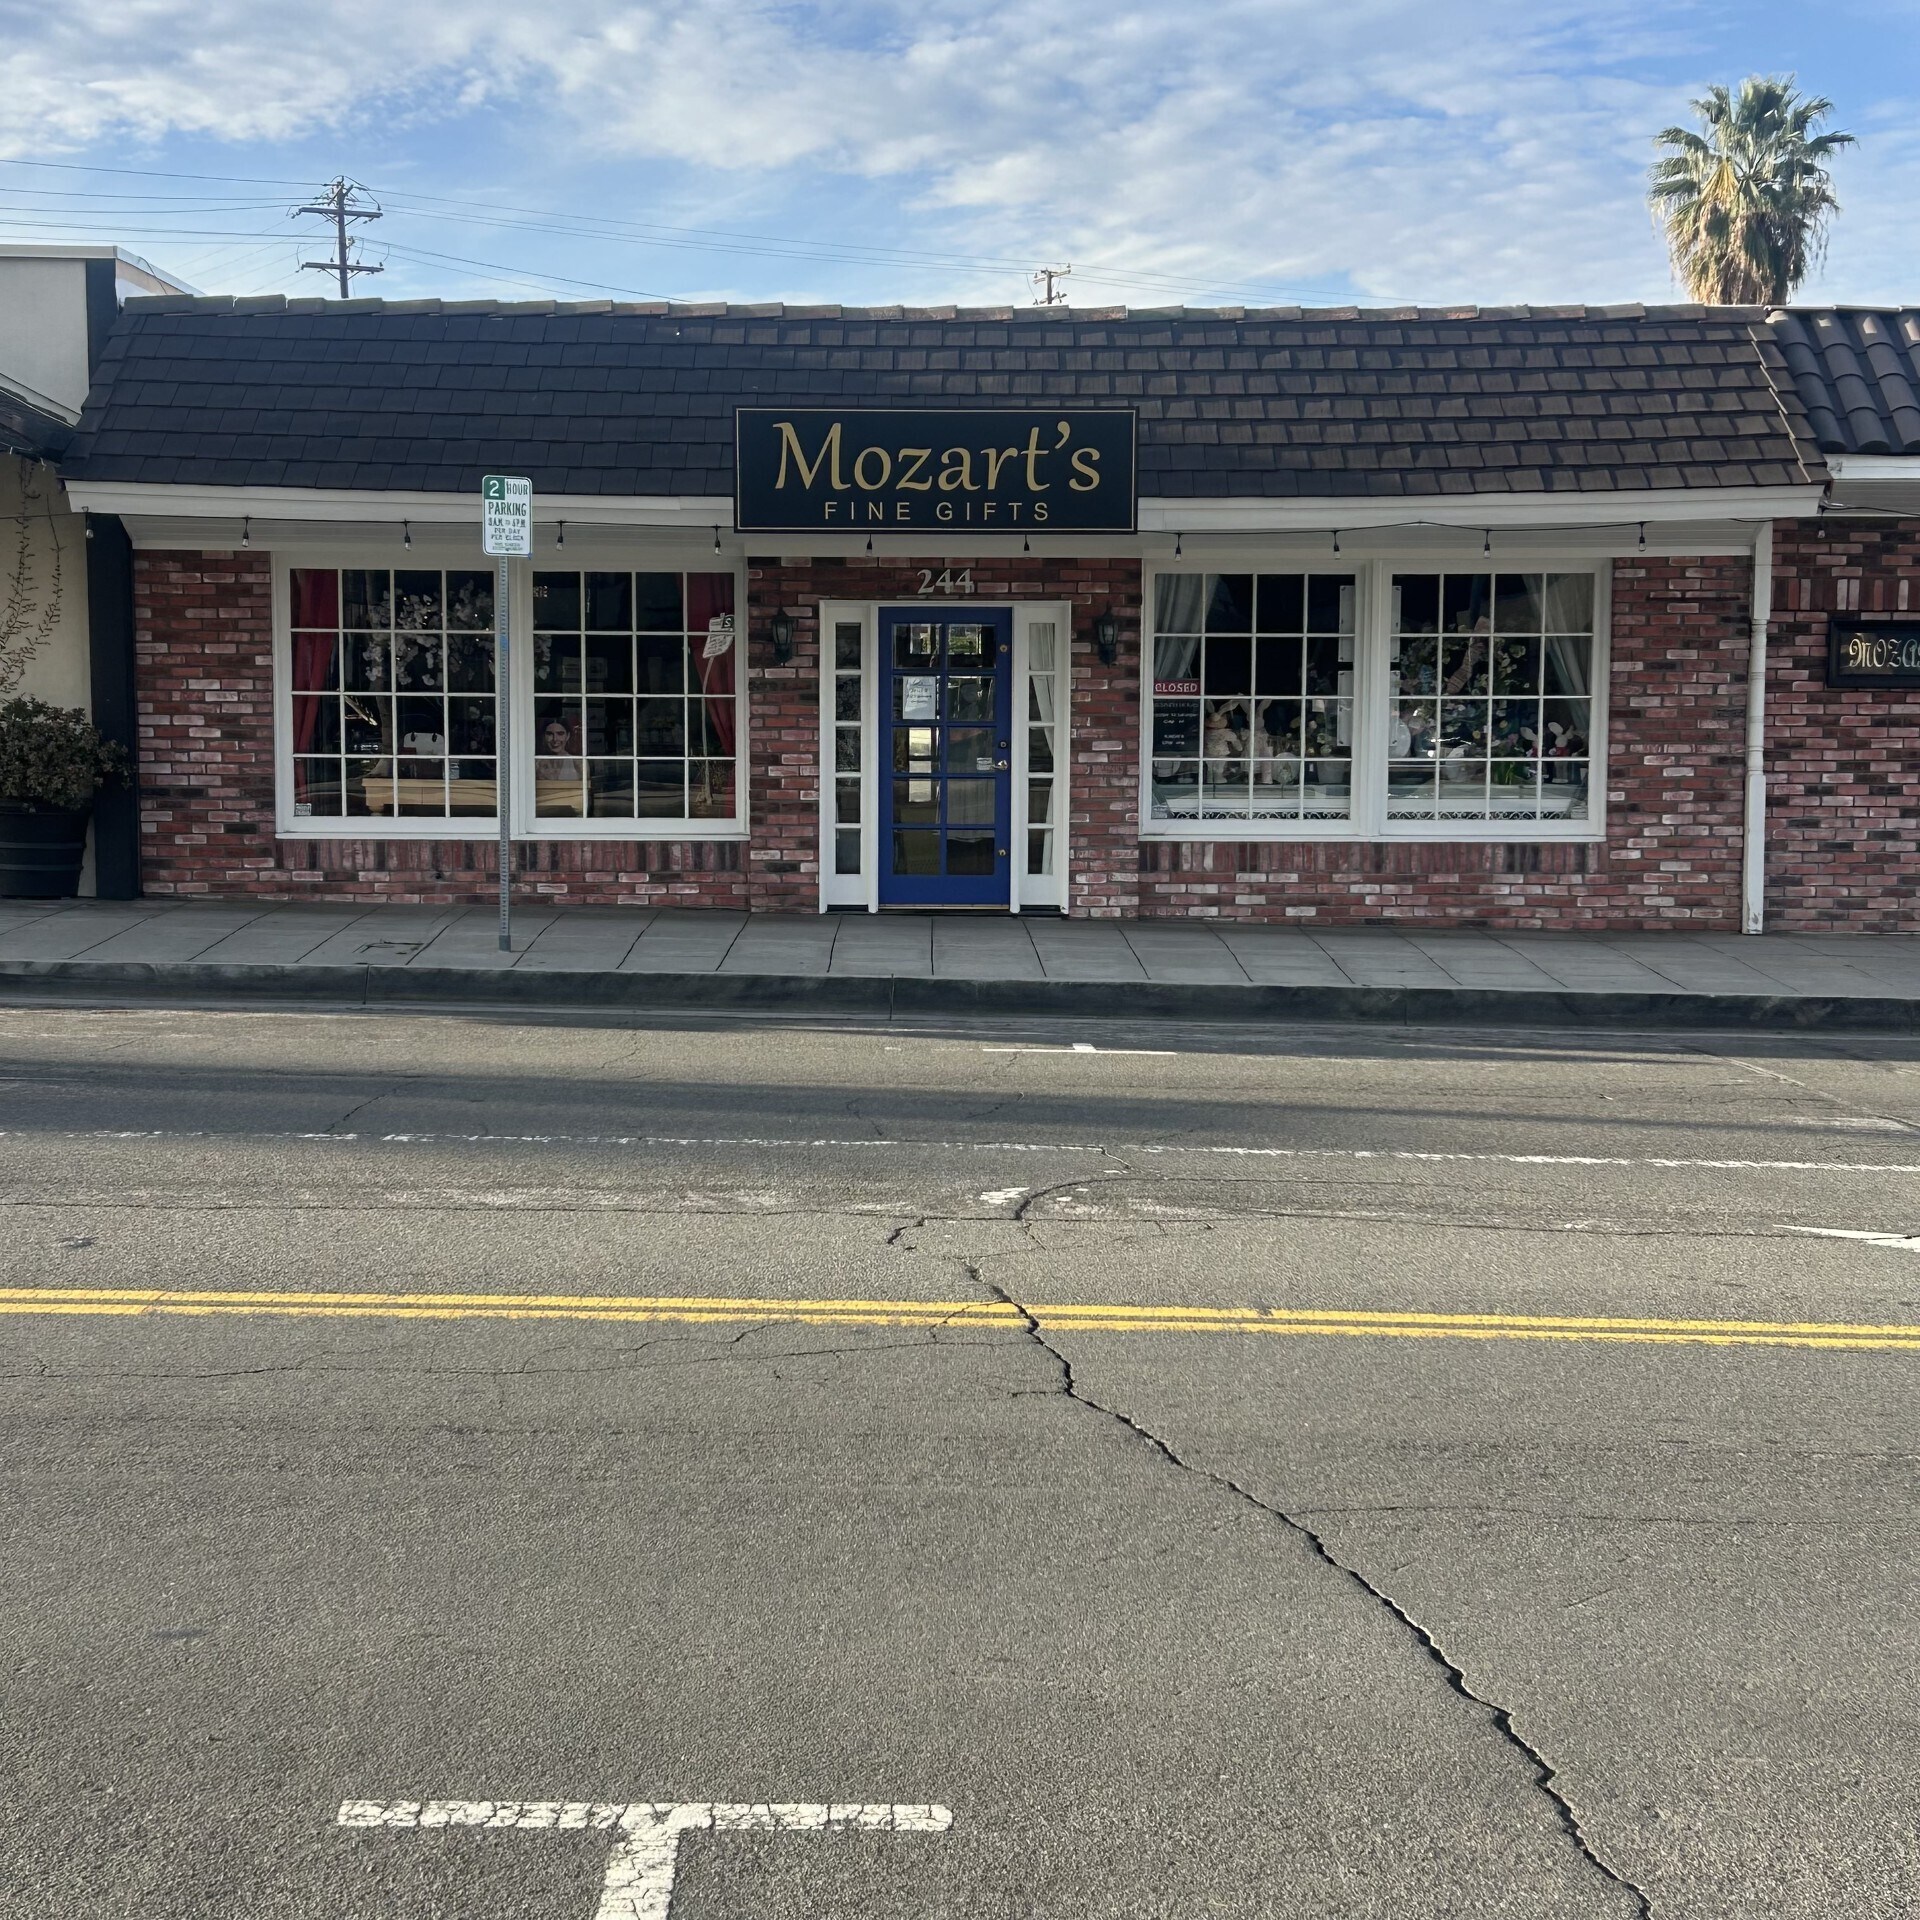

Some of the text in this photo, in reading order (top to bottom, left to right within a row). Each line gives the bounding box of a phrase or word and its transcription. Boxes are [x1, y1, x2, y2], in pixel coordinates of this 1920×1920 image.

[772, 420, 1101, 492] Mozart's
[490, 480, 528, 496] 2 HOUR
[488, 502, 527, 516] PARKING
[824, 502, 1049, 521] FINE GIFTS
[917, 569, 975, 594] 244
[1155, 683, 1198, 692] CLOSED
